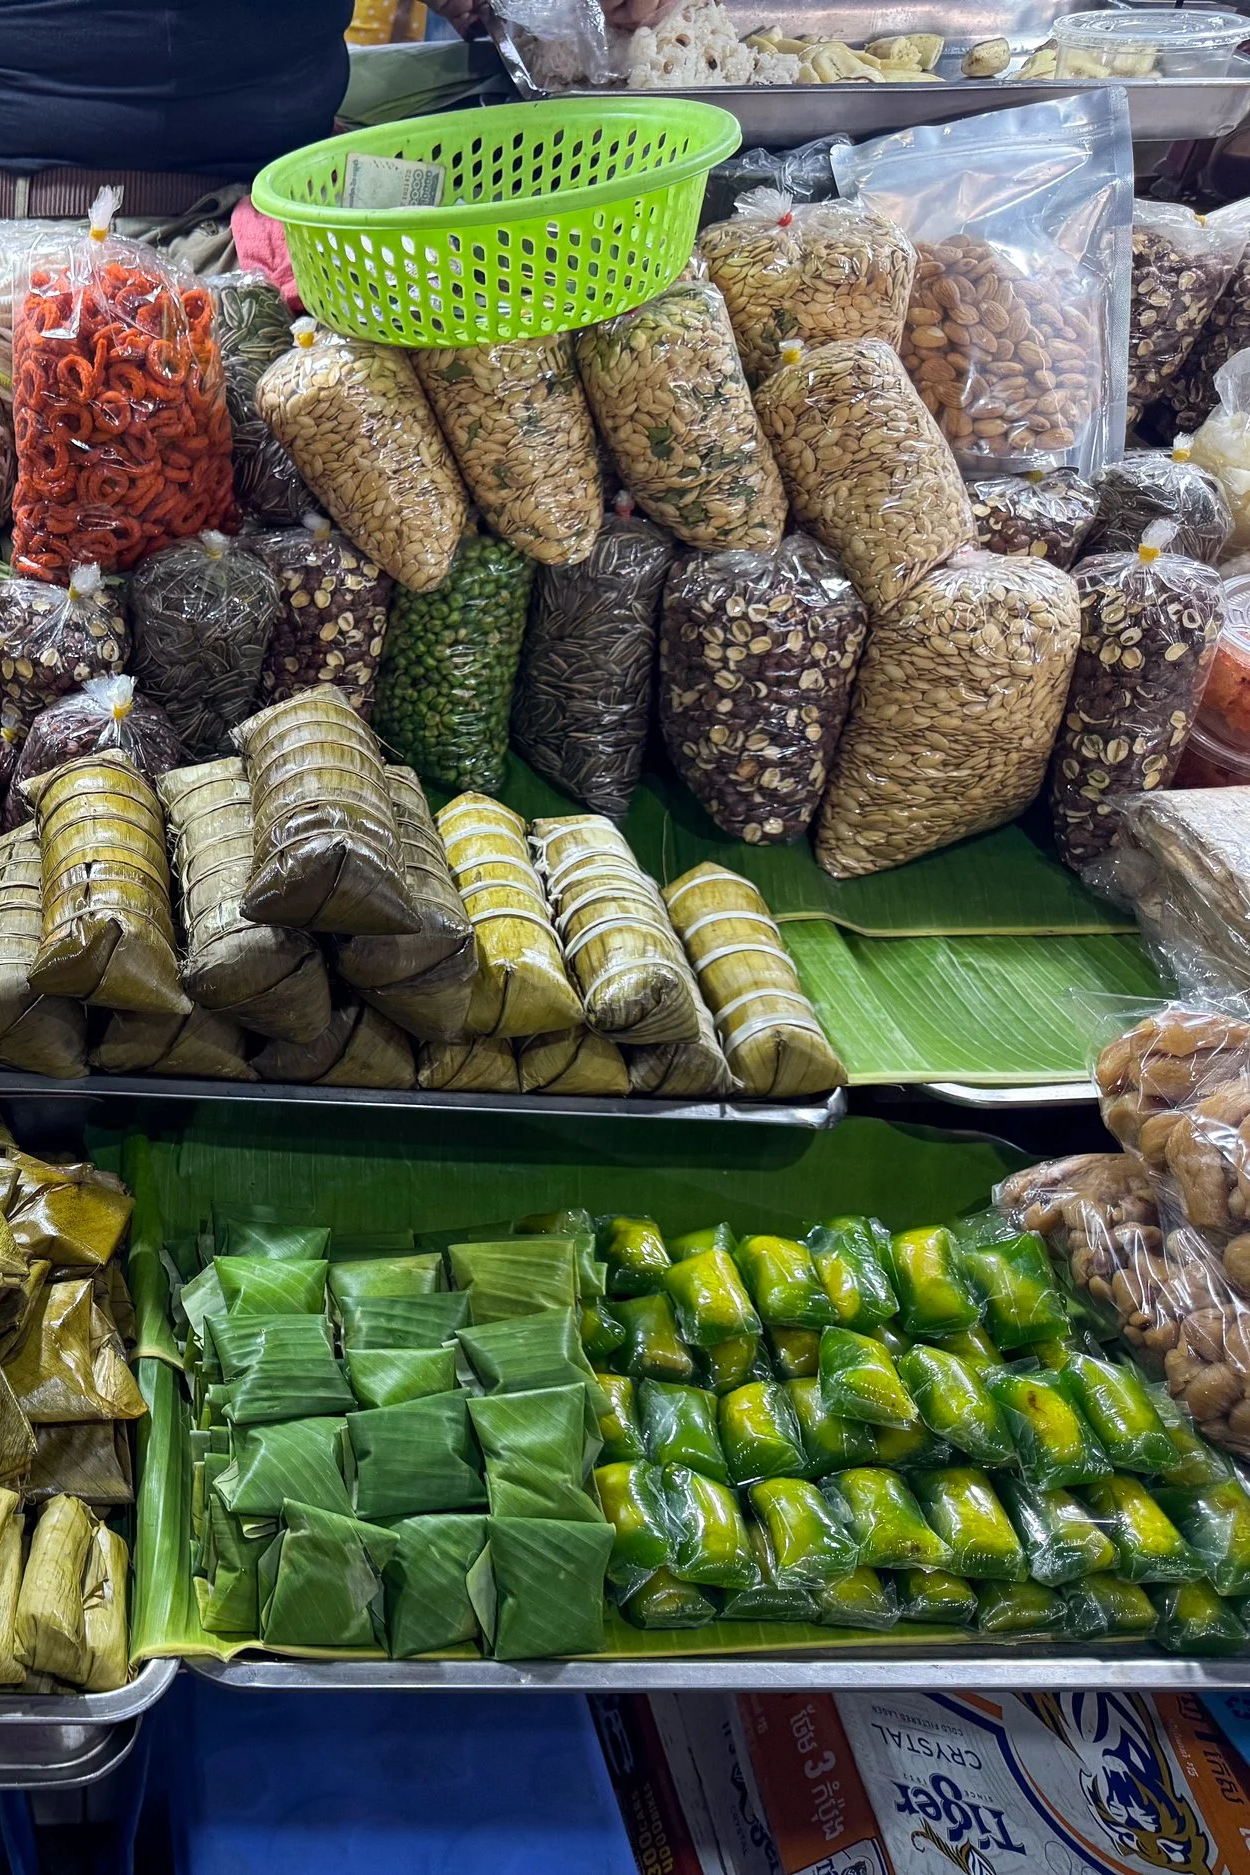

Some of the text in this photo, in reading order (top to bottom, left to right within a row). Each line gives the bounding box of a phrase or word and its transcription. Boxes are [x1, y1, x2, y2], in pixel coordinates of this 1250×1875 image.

[870, 1704, 964, 1736] COLD FILTERED LAGER
[870, 1722, 983, 1771] CRYSTAL
[803, 1749, 837, 1780] 3
[963, 1789, 994, 1802] SINCE
[889, 1773, 1027, 1857] Tiger
